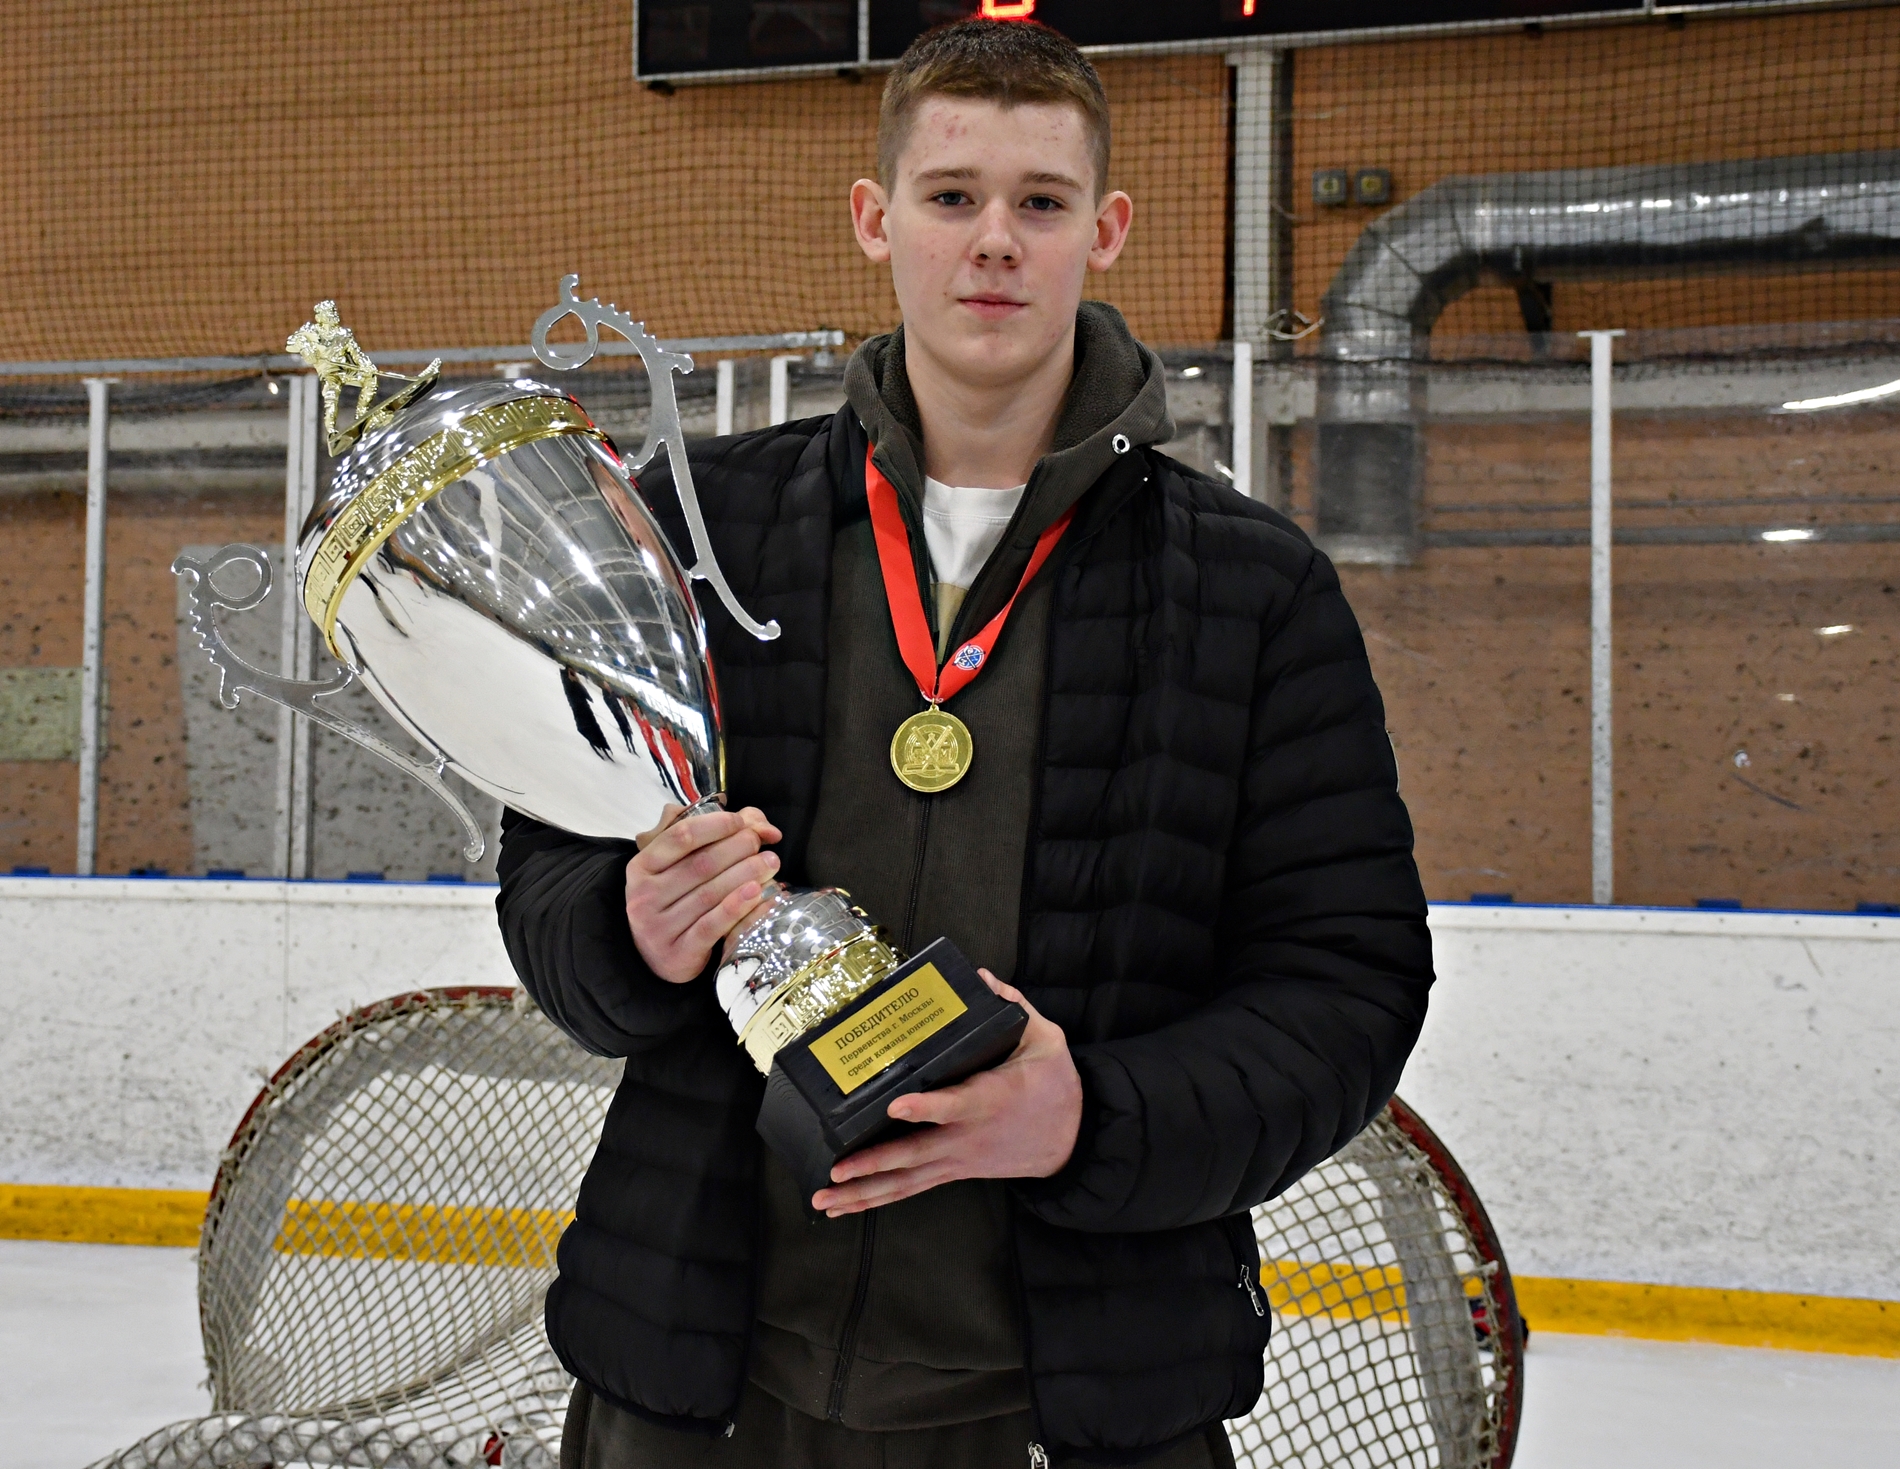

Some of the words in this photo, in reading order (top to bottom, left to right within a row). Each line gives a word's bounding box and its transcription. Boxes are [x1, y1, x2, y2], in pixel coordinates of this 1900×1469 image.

[834, 987, 920, 1050] ПОБЕДИТЕЛЮ
[840, 1027, 892, 1065] Первенства
[892, 1022, 900, 1030] г.
[899, 997, 935, 1024] Москвы
[847, 1057, 874, 1077] среди
[874, 1035, 908, 1059] команд
[907, 1007, 945, 1036] юниоров
